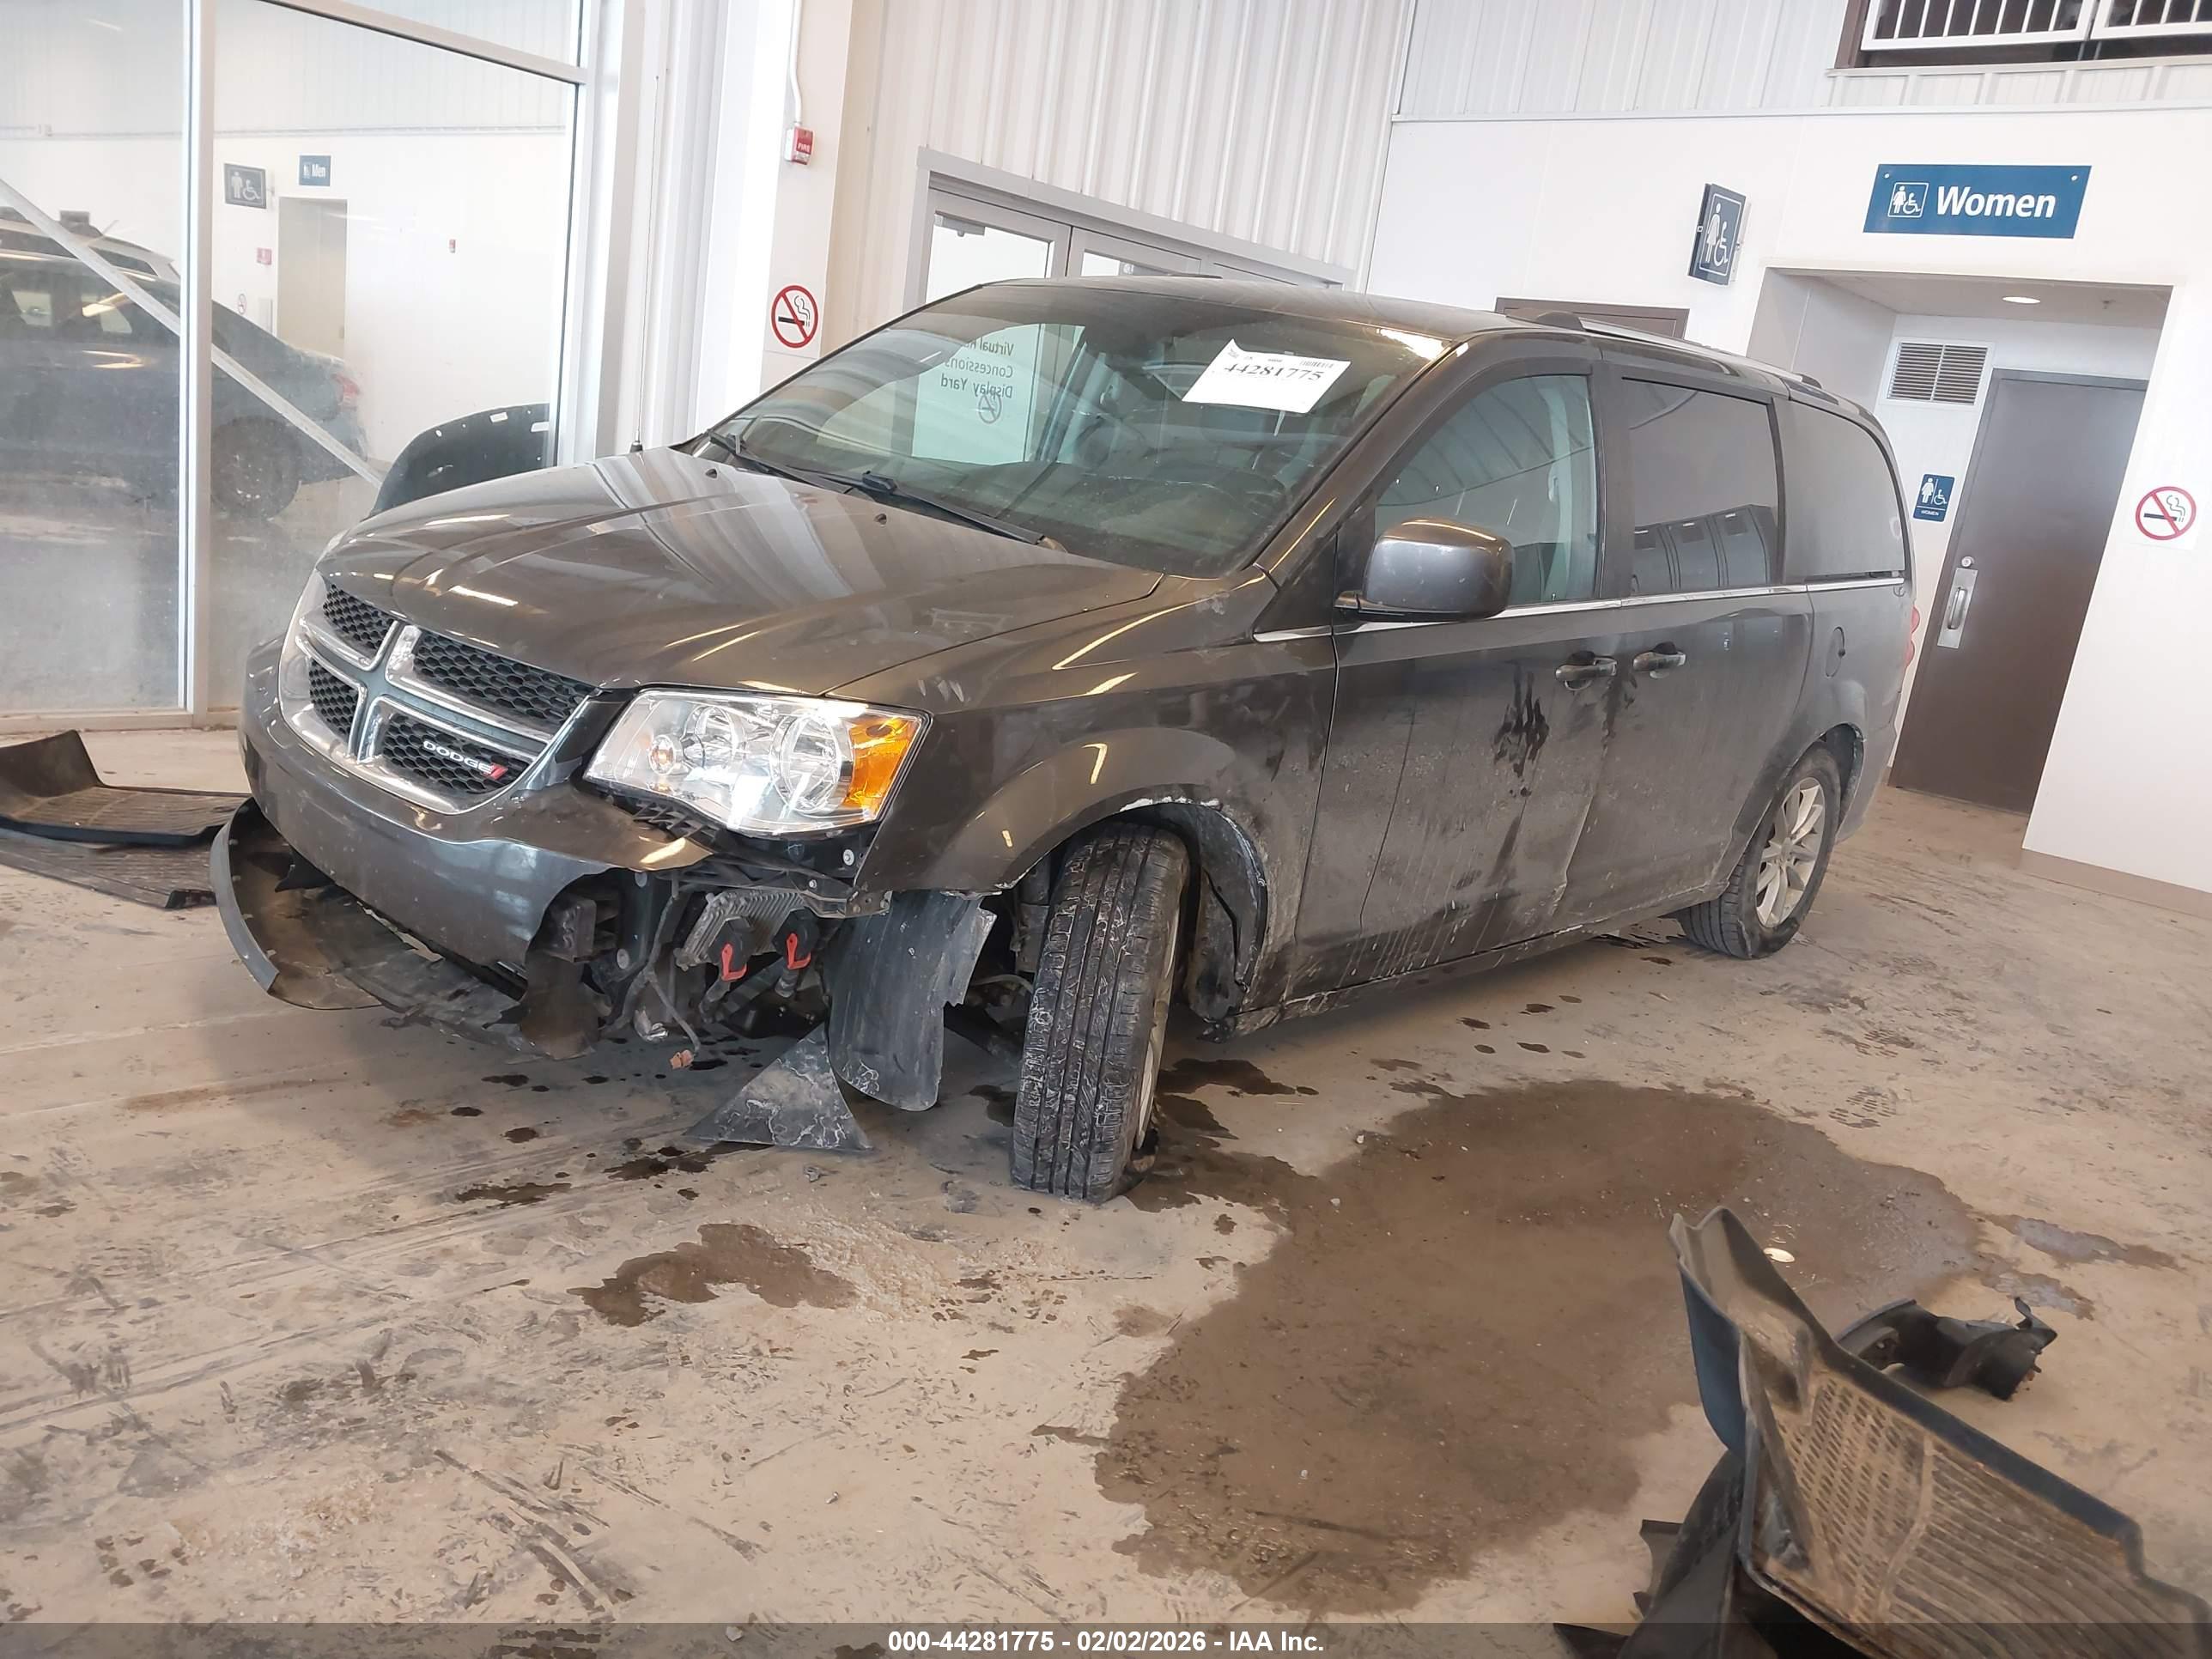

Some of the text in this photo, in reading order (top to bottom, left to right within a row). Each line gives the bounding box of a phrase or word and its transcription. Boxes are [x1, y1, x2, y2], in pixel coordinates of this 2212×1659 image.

[1936, 185, 2056, 218] Women
[1224, 363, 1325, 381] 44281775
[423, 740, 495, 775] DODGE
